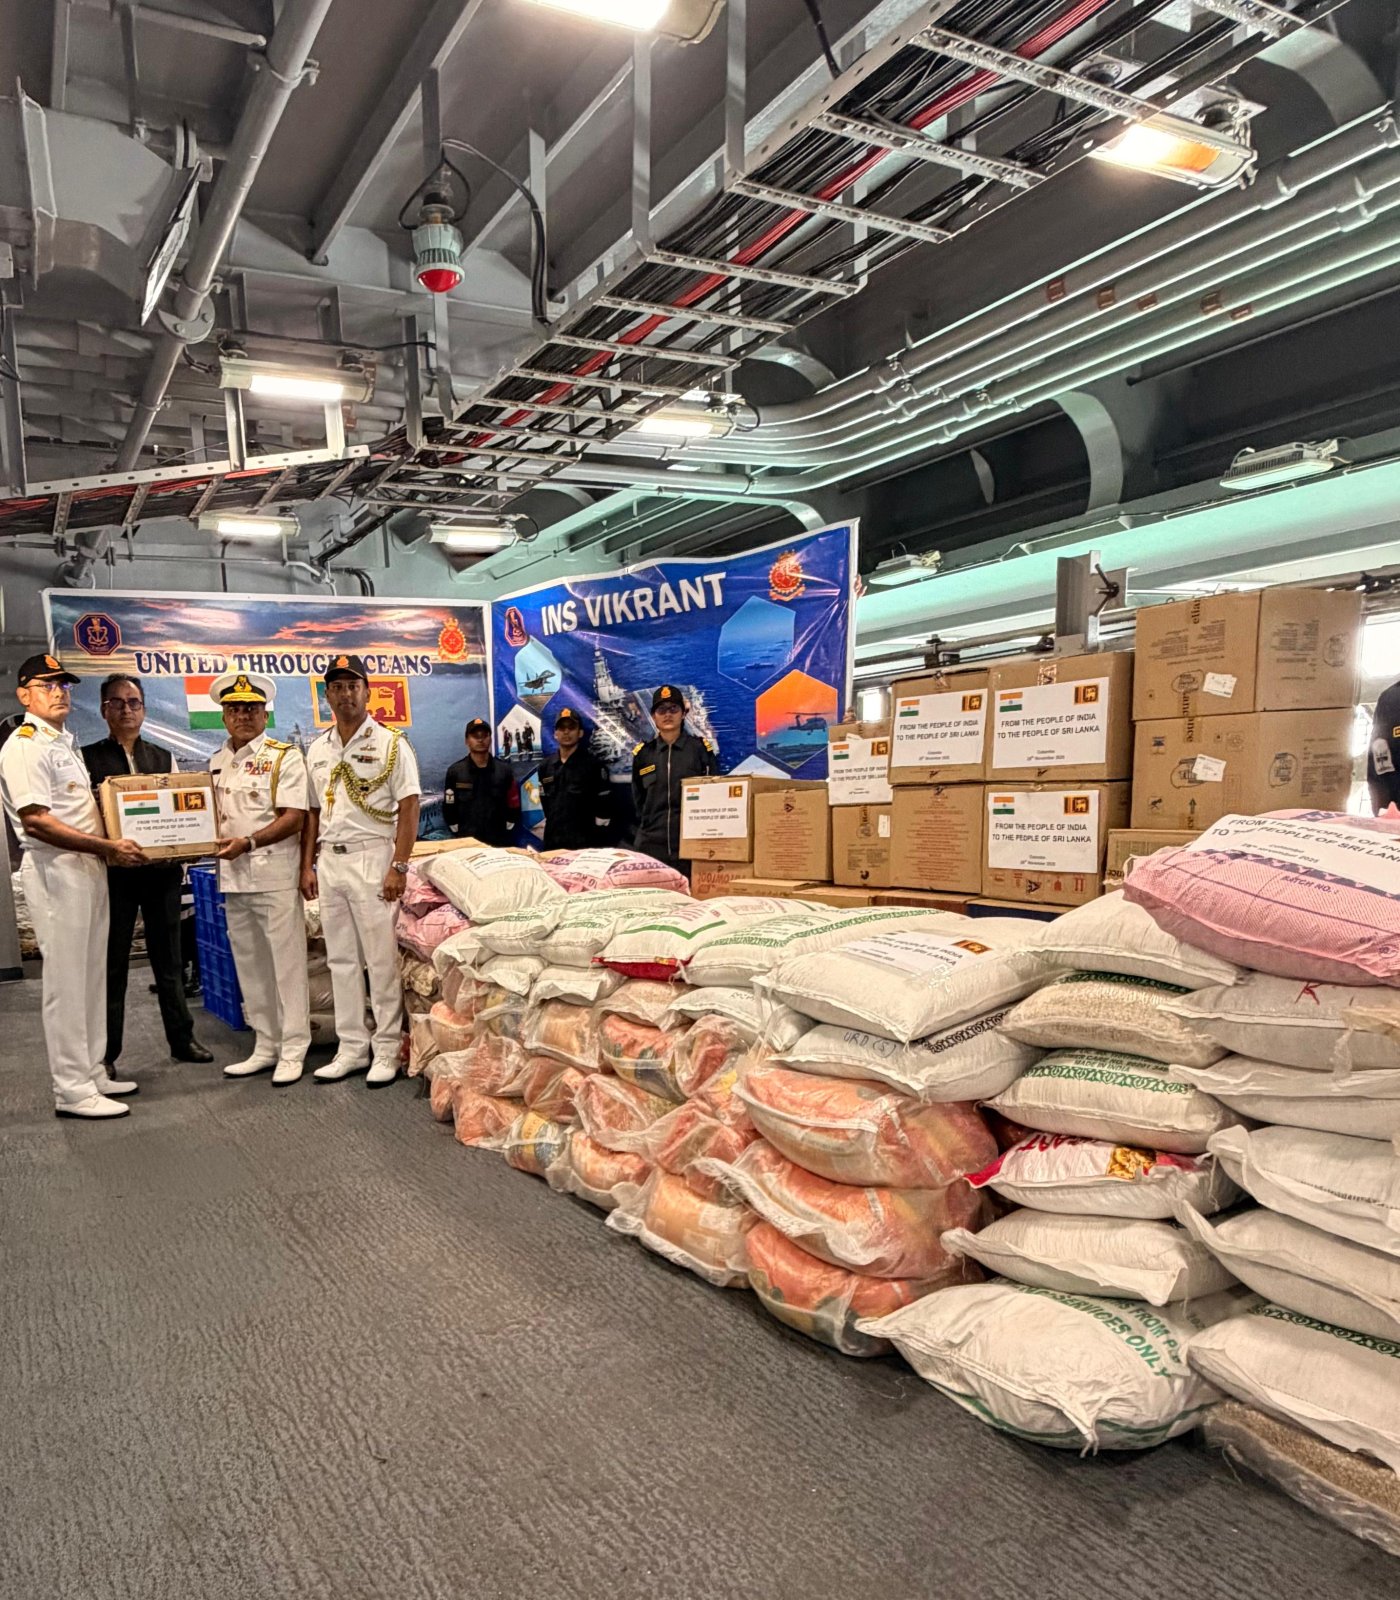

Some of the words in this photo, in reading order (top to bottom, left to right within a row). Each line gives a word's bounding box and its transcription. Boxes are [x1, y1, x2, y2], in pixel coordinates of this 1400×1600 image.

[541, 600, 578, 636] INS
[583, 572, 726, 627] VIKRANT
[134, 652, 228, 674] UNITED
[360, 655, 433, 674] CEANS
[900, 723, 916, 731] FROM
[917, 722, 928, 730] THE
[929, 721, 953, 729] PEOPLE
[963, 719, 979, 727] INDIA
[1021, 718, 1035, 726] THE
[1036, 716, 1064, 725] PEOPLE
[1065, 714, 1076, 722] OF
[1077, 713, 1096, 721] INDIA
[916, 732, 939, 740] PEOPLE
[960, 730, 979, 738] LANKA
[1022, 729, 1049, 737] PEOPLE
[1050, 728, 1060, 736] OF
[1061, 726, 1073, 735] SRI
[1075, 725, 1100, 734] LANKA
[1027, 823, 1054, 831] PEOPLE
[1067, 823, 1087, 831] INDIA
[992, 833, 1000, 841] TO
[1015, 834, 1039, 842] PEOPLE
[1052, 835, 1065, 843] SRI
[1066, 835, 1091, 843] LANKA
[1211, 828, 1230, 836] TO
[1257, 826, 1313, 840] PEOPLE
[1314, 836, 1337, 846] OF
[1338, 842, 1365, 852] SRI
[1297, 825, 1355, 841] PEOPLE
[1358, 838, 1382, 847] OF
[1107, 1063, 1130, 1072] INDIA
[1128, 1308, 1171, 1338] FROM
[1125, 1335, 1171, 1378] ONLY
